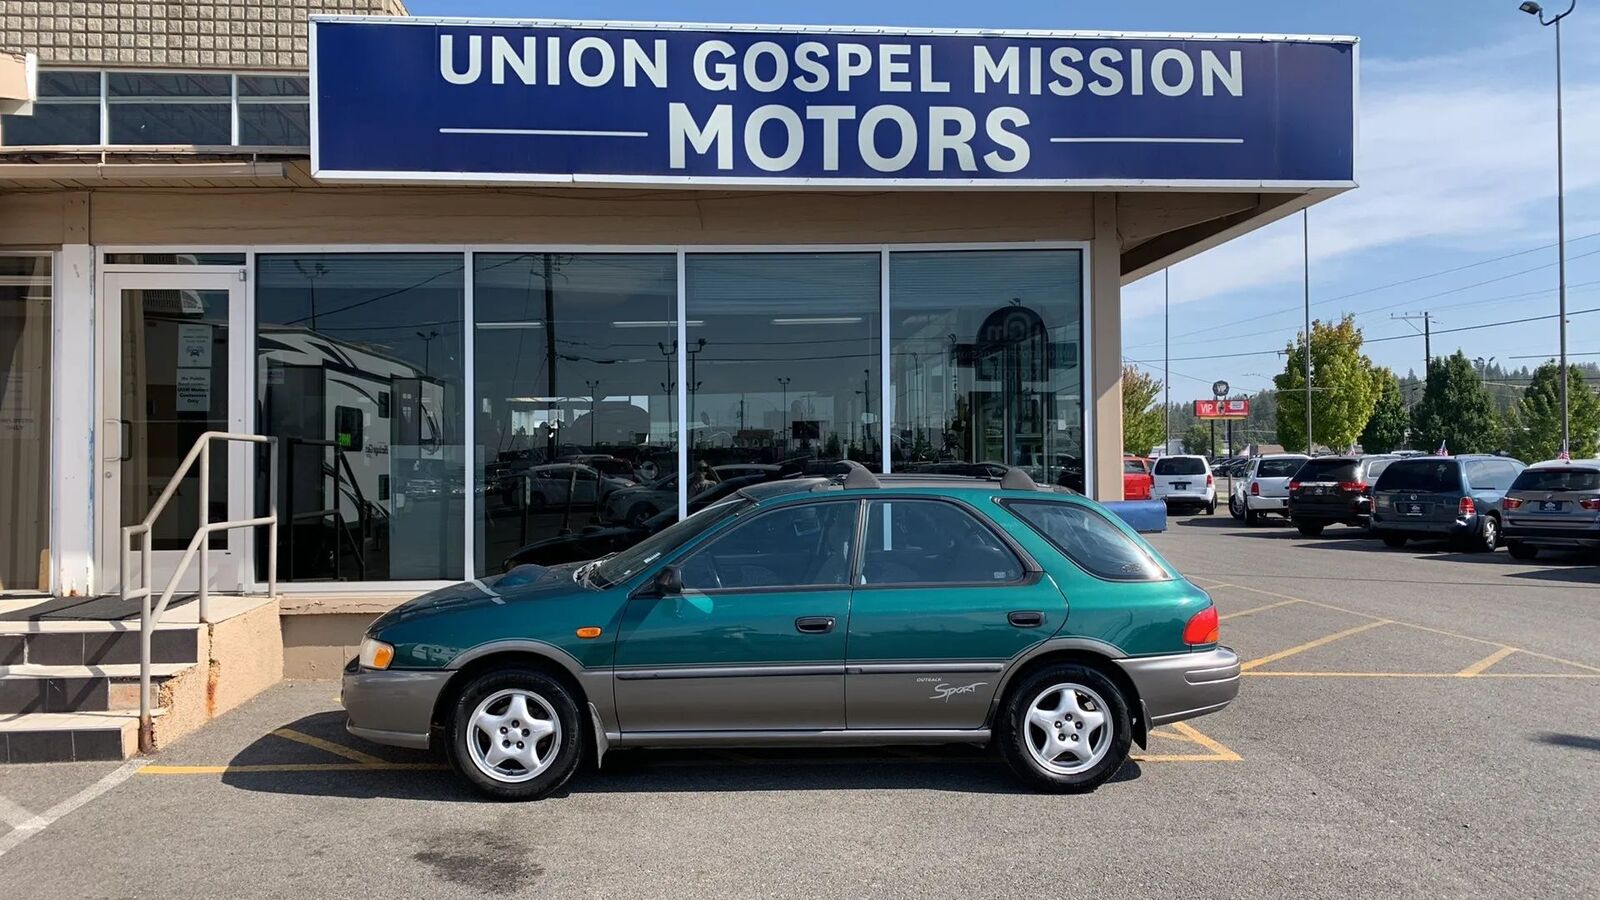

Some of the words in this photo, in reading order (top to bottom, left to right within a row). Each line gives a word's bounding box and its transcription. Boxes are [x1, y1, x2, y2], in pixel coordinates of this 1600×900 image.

[440, 35, 668, 88] UNION
[693, 40, 951, 93] GOSPEL
[973, 45, 1243, 97] MISSION
[669, 102, 1031, 173] MOTORS
[1200, 404, 1213, 414] VIP
